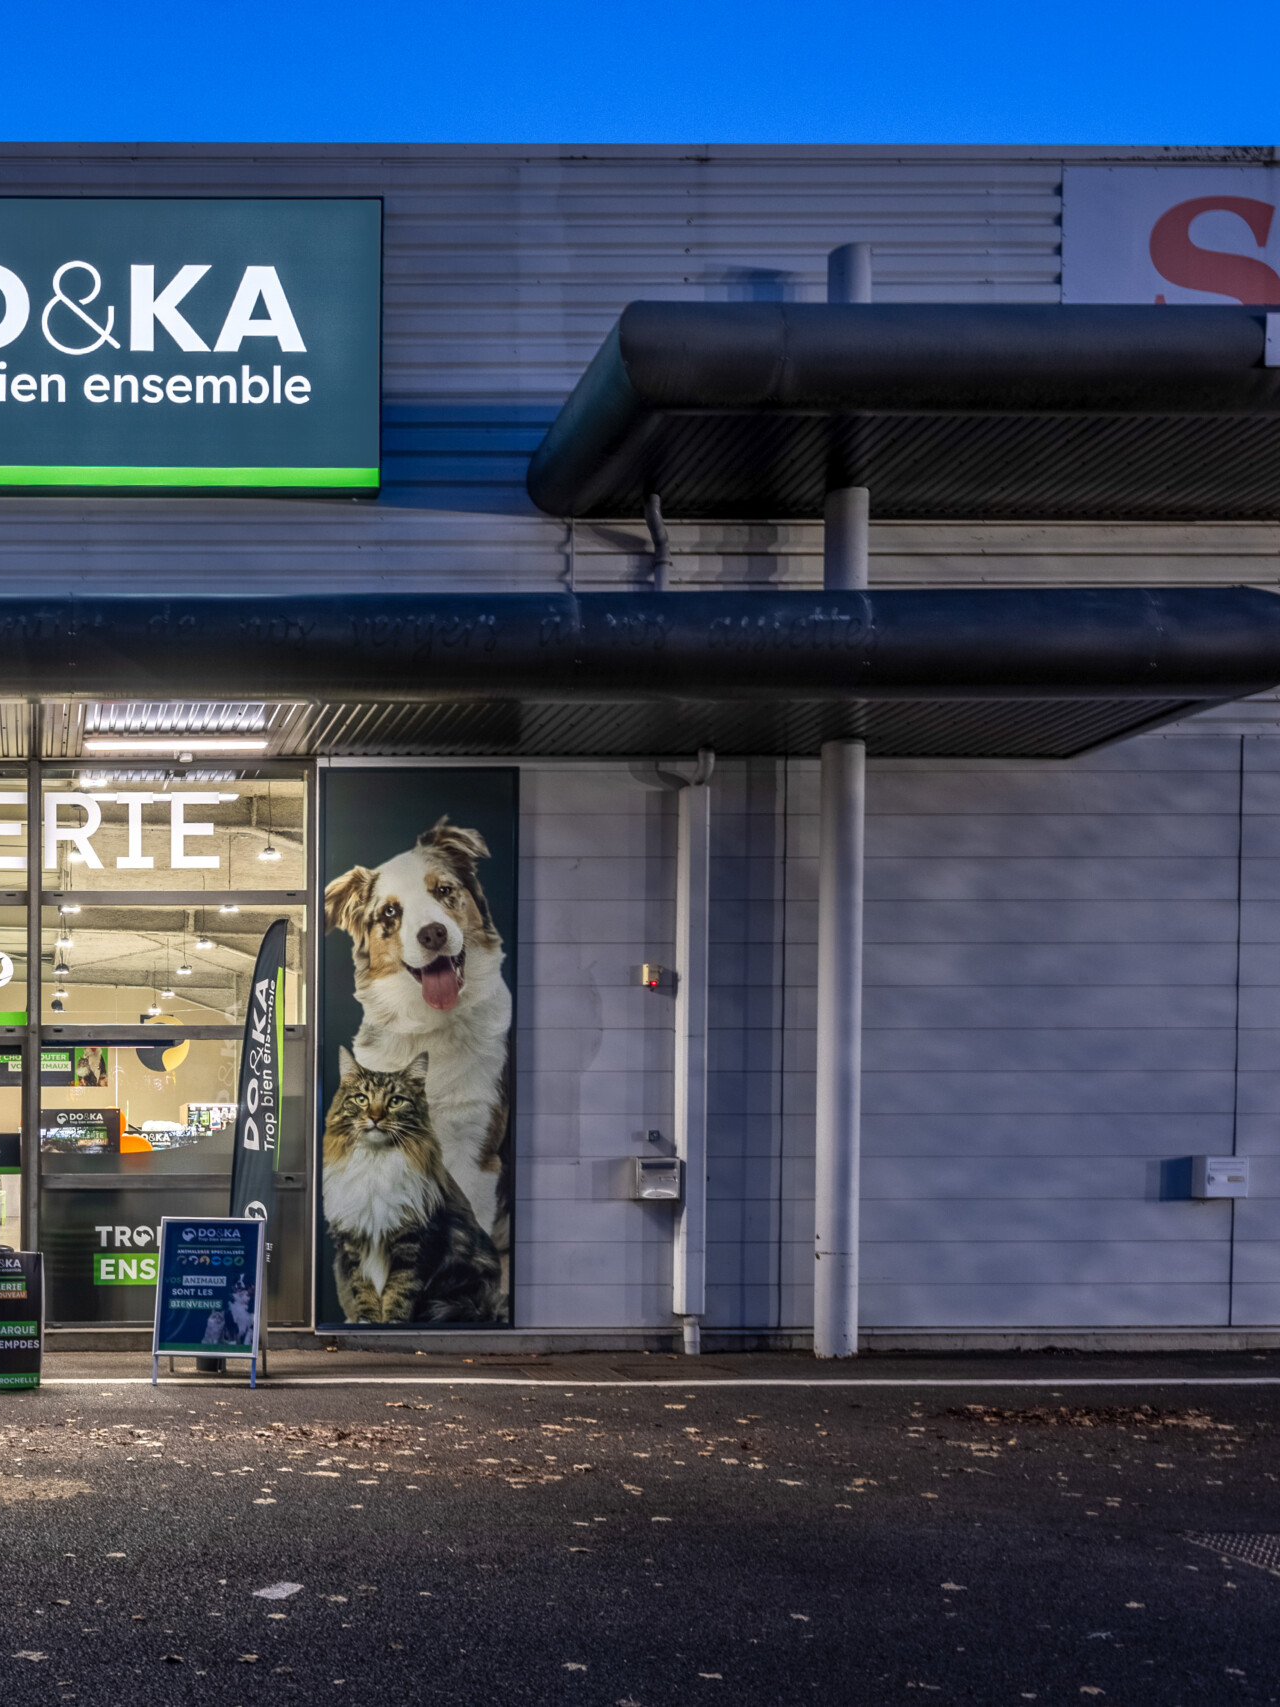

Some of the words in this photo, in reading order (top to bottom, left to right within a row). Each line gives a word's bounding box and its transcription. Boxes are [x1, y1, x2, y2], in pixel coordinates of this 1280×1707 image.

[83, 365, 312, 405] ensemble
[243, 977, 269, 1151] DO&KA
[260, 1069, 274, 1108] bien
[263, 1112, 277, 1152] Trop
[198, 1228, 241, 1238] DO&KA
[184, 1277, 225, 1285] ANIMAUX
[172, 1288, 195, 1296] SONT
[198, 1288, 213, 1296] LES
[170, 1300, 221, 1308] BIENVENUS
[0, 1376, 38, 1384] ROCHELLE
